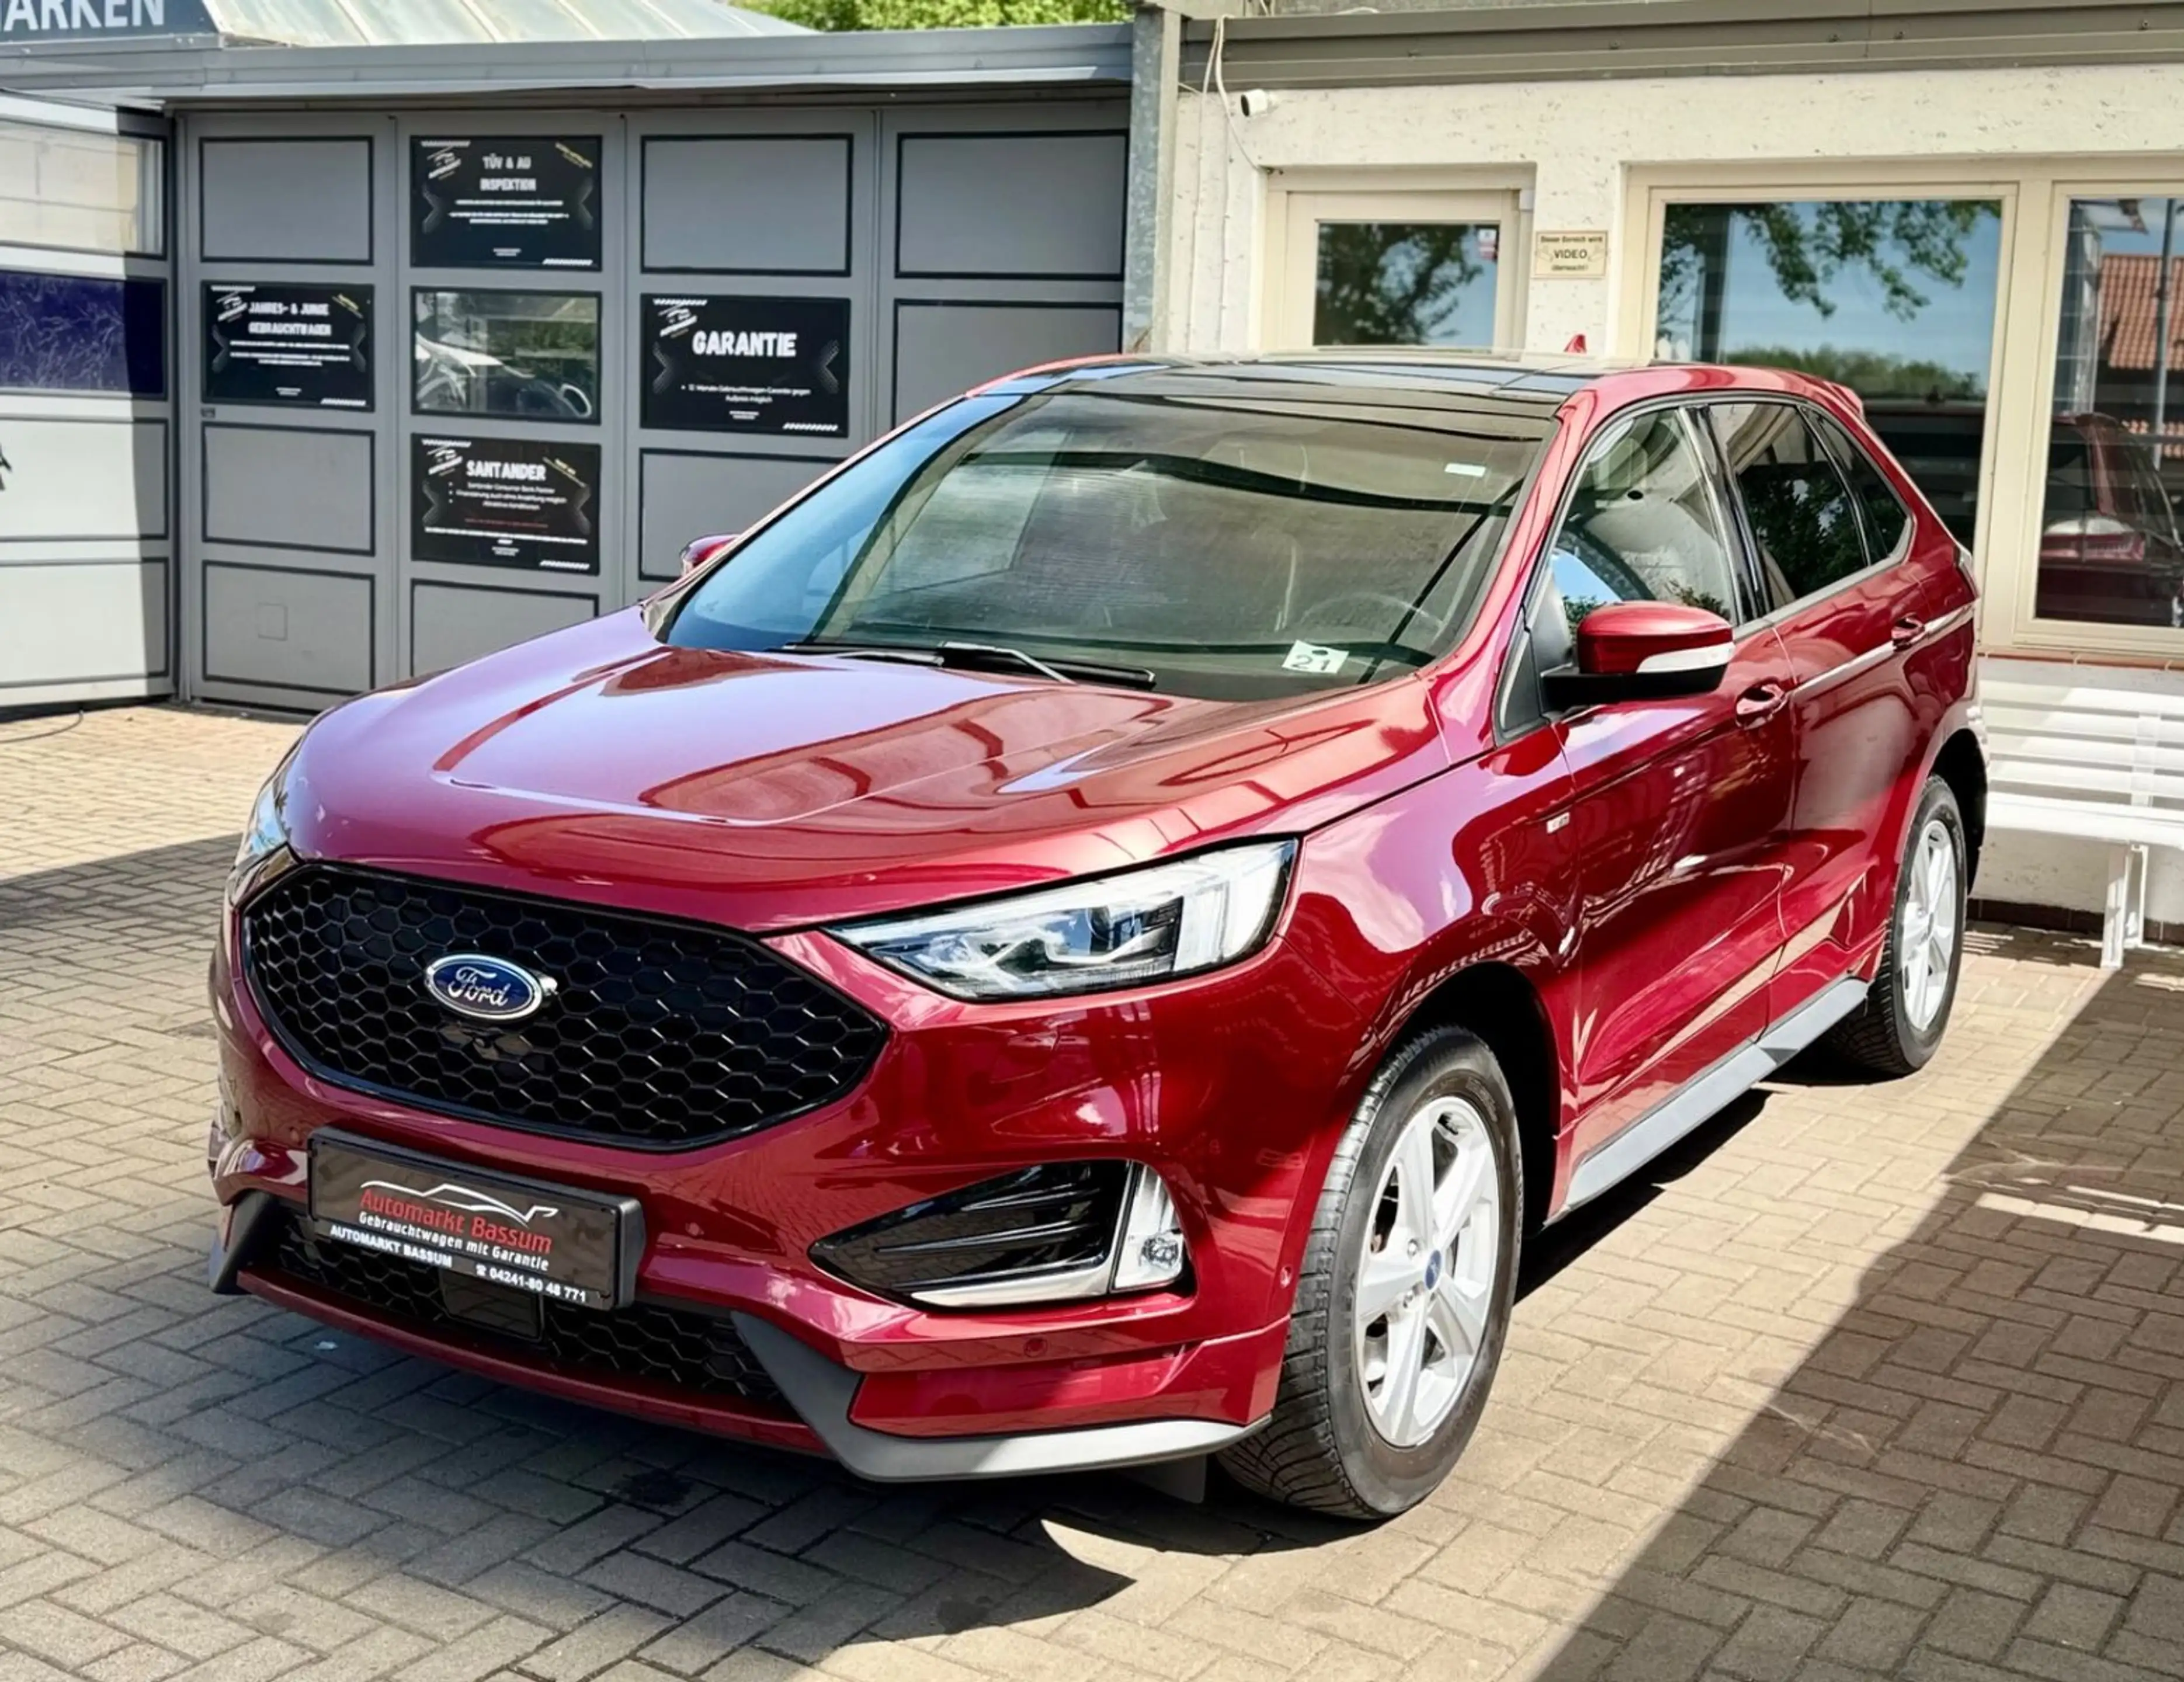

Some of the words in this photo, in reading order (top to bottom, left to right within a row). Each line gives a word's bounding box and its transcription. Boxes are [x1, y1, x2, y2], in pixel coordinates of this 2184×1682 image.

[0, 0, 165, 32] ARKEN
[1553, 248, 1588, 259] VIDEO
[692, 329, 797, 357] GARANTIE
[466, 460, 547, 481] SANTANDER
[1290, 654, 1331, 671] 21
[447, 965, 511, 1007] Ford
[360, 1188, 465, 1234] Automarkt
[471, 1215, 553, 1254] Bassum
[329, 1224, 401, 1253] AUTOMARKT
[402, 1243, 453, 1268] BASSUM
[358, 1211, 463, 1250] Gebrauchtwagen
[466, 1239, 489, 1256] mit
[492, 1245, 550, 1271] Garantie
[489, 1266, 543, 1292] 04241-80
